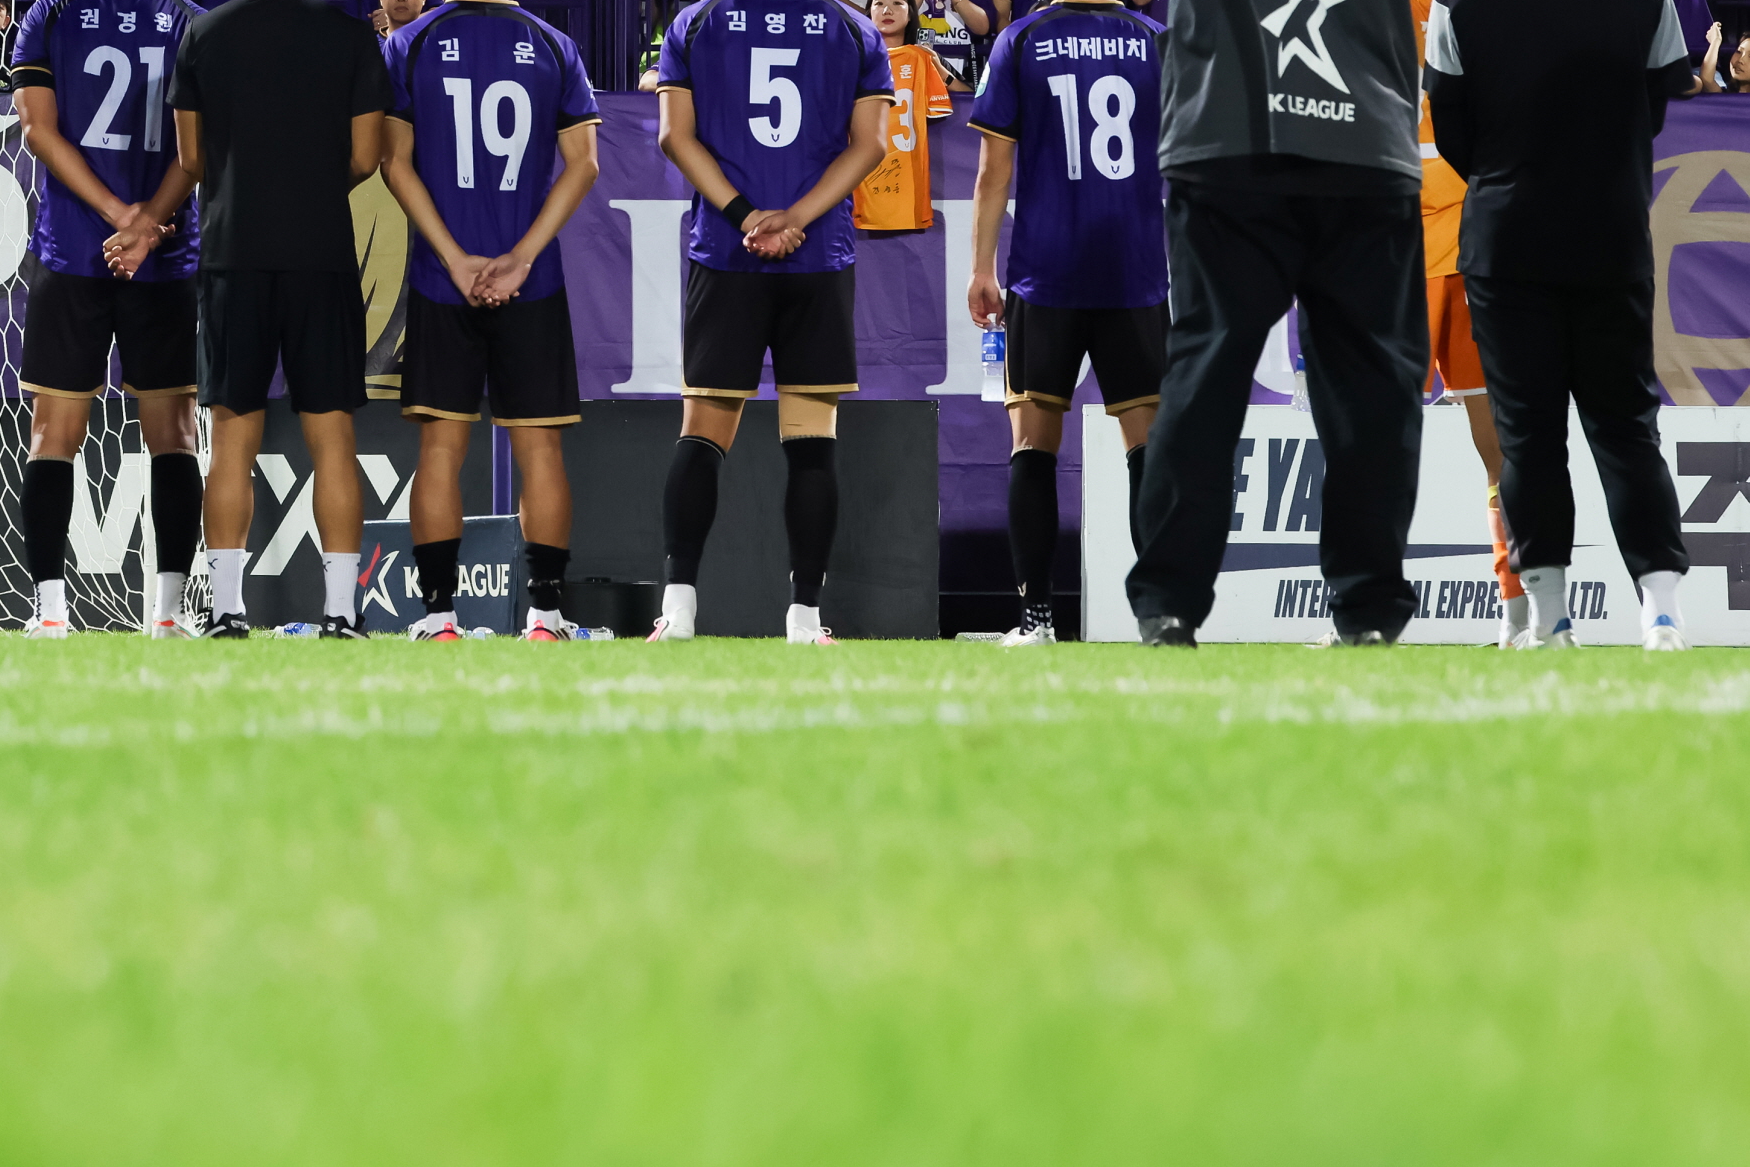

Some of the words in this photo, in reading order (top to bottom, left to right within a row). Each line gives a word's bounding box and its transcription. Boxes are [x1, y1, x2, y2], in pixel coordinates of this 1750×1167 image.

[80, 8, 174, 34] 권경원
[726, 11, 827, 36] 김영찬
[1034, 37, 1148, 63] 크네제비치
[80, 46, 165, 152] 21
[749, 47, 802, 148] 5
[1268, 94, 1285, 112] K
[1288, 95, 1356, 123] LEAGUE
[443, 77, 532, 192] 19
[1047, 74, 1137, 181] 18
[1435, 580, 1504, 619] EXPRE
